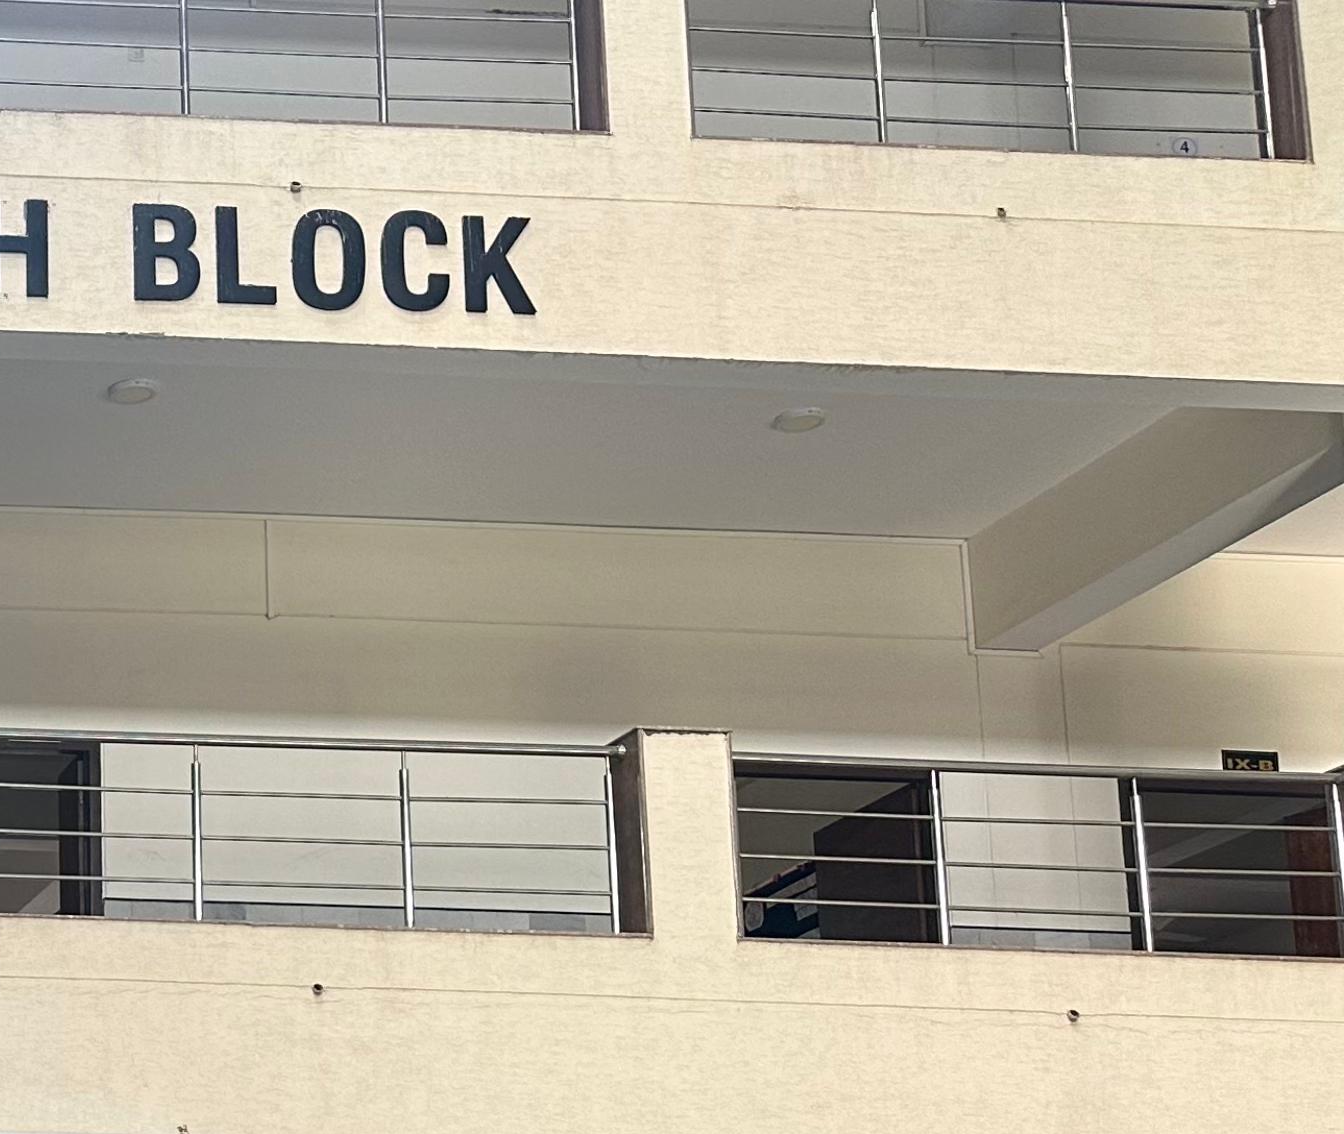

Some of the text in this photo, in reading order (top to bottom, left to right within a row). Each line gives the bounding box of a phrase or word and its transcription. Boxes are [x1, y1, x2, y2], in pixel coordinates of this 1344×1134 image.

[1180, 141, 1189, 153] 4
[131, 202, 538, 315] BLOCK
[1226, 757, 1274, 771] IX-B
